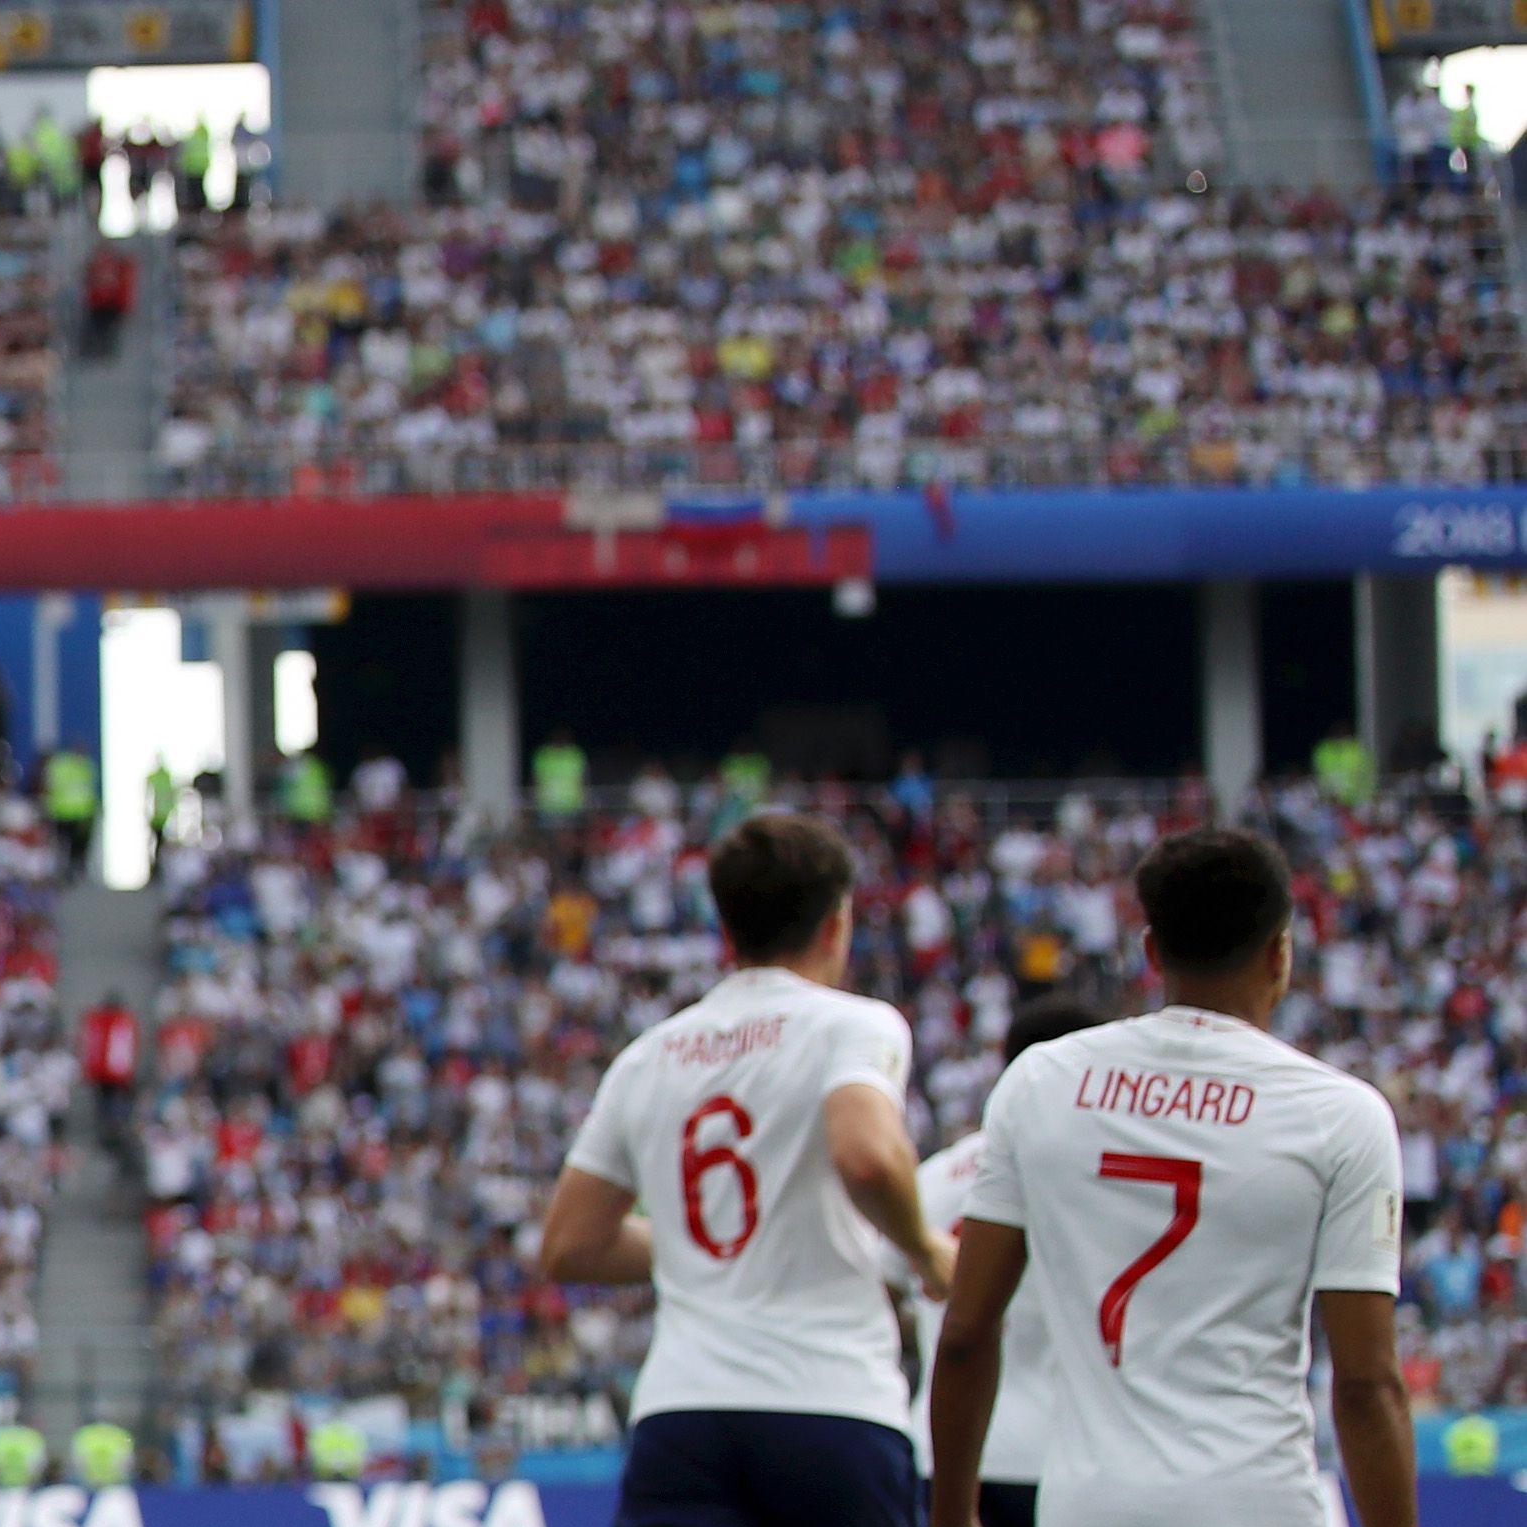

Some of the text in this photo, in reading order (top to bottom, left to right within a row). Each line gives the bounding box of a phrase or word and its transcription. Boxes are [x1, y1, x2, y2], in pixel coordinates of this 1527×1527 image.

[680, 1095, 759, 1263] 6
[1074, 1065, 1256, 1126] LINGARD
[1098, 1152, 1203, 1369] 7
